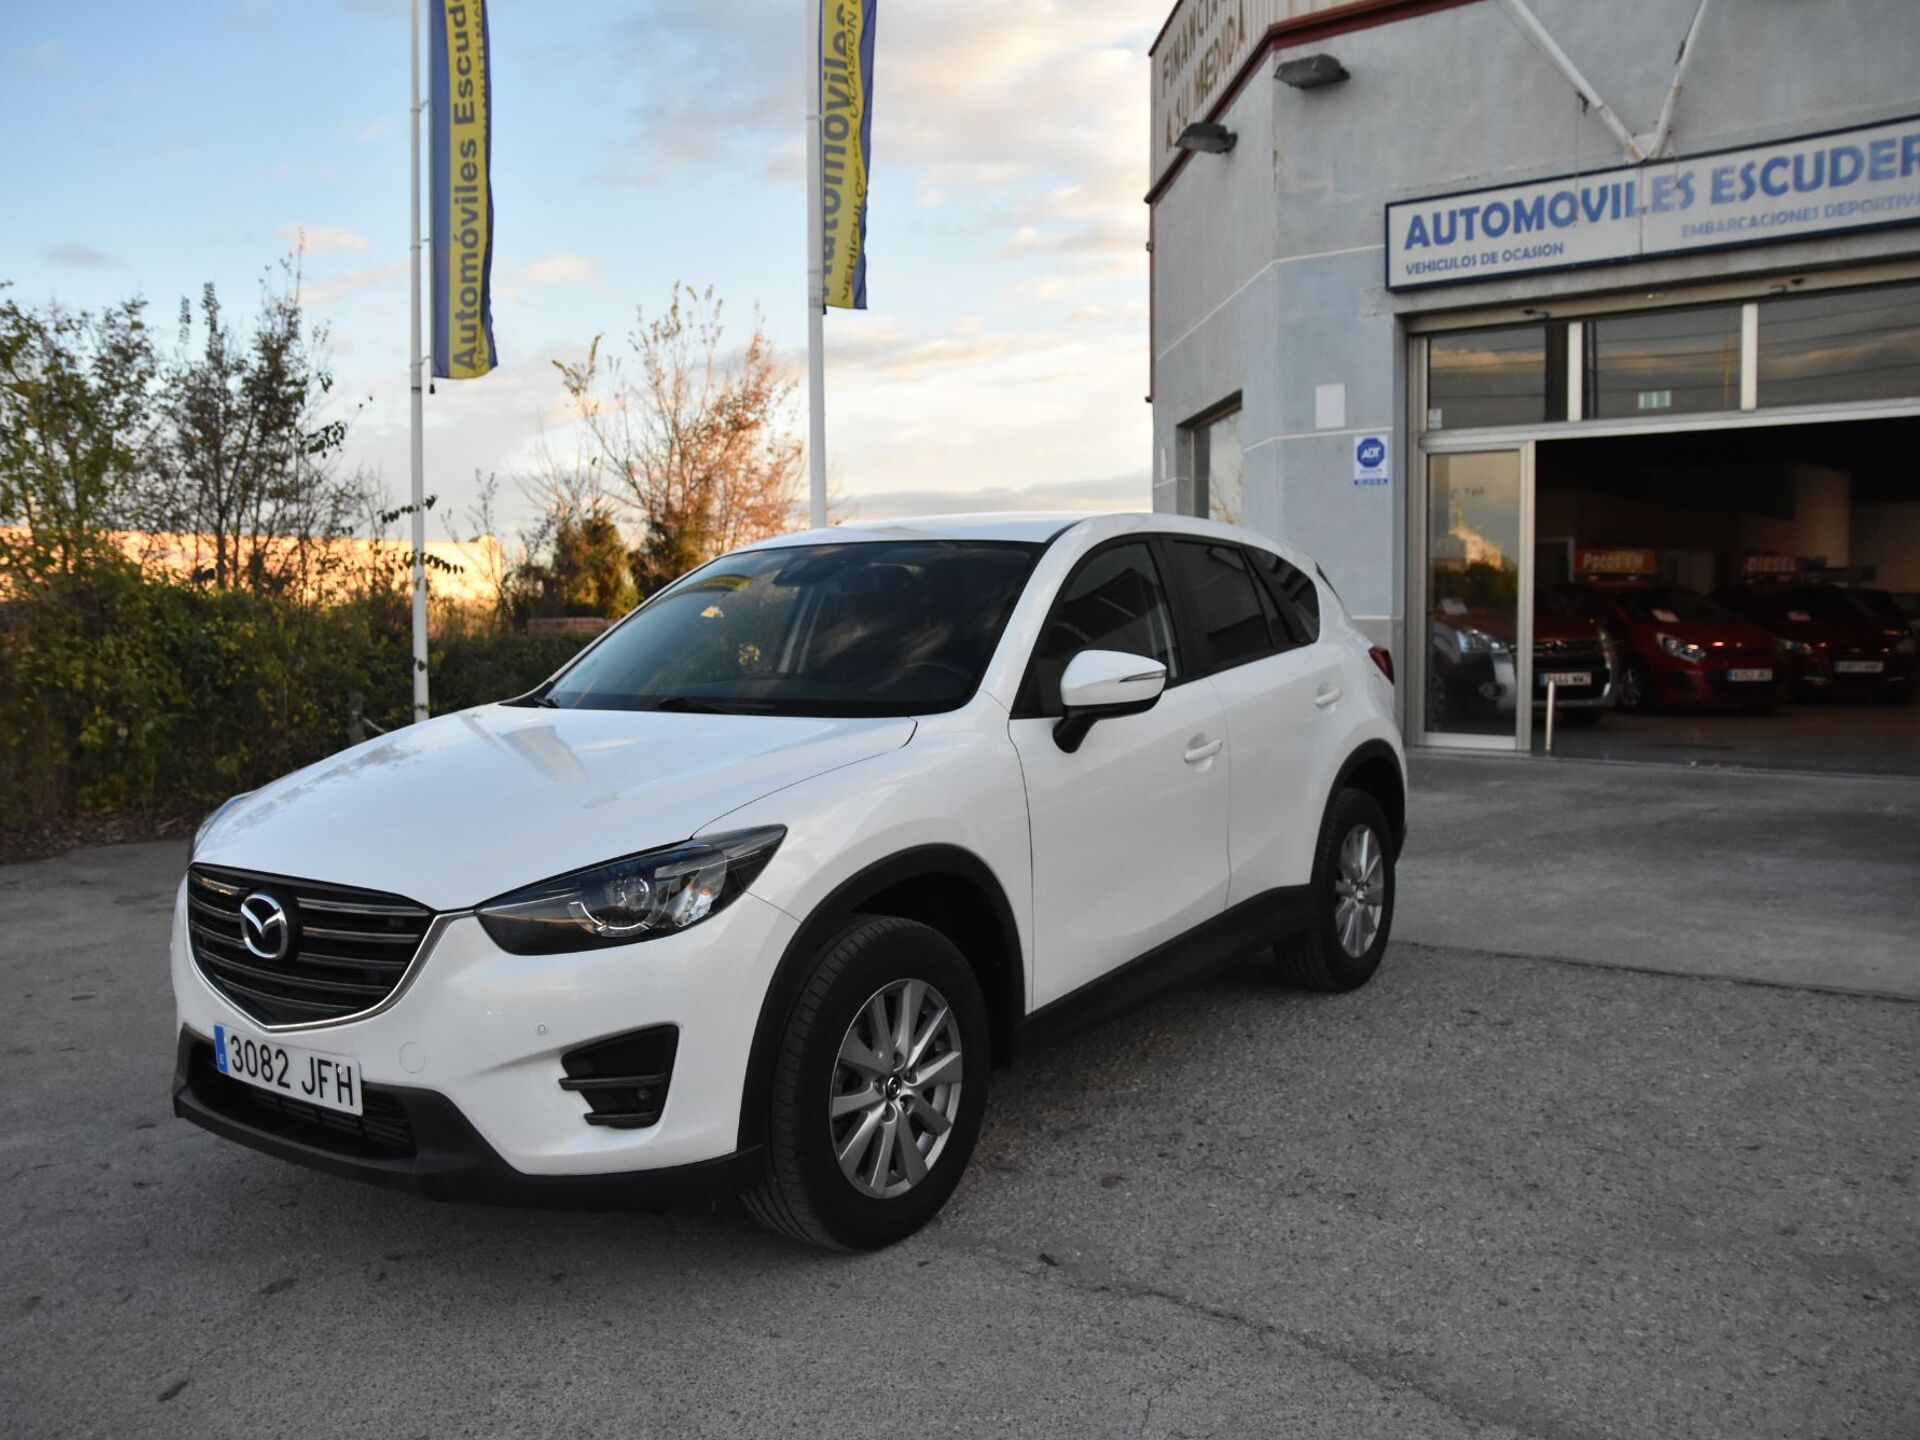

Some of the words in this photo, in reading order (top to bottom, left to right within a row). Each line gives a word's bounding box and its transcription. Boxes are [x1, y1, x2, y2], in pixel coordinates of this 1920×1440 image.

[449, 0, 475, 125] Escud
[1404, 171, 1695, 250] AUTOMOVILES
[1681, 206, 1820, 238] EMBARCACIONES
[452, 138, 479, 371] Automóviles
[1405, 254, 1477, 276] VEHICULOS
[1483, 251, 1499, 265] DE
[1503, 243, 1564, 262] OCASION
[230, 1035, 291, 1090] 3082
[301, 1056, 354, 1107] JFH
